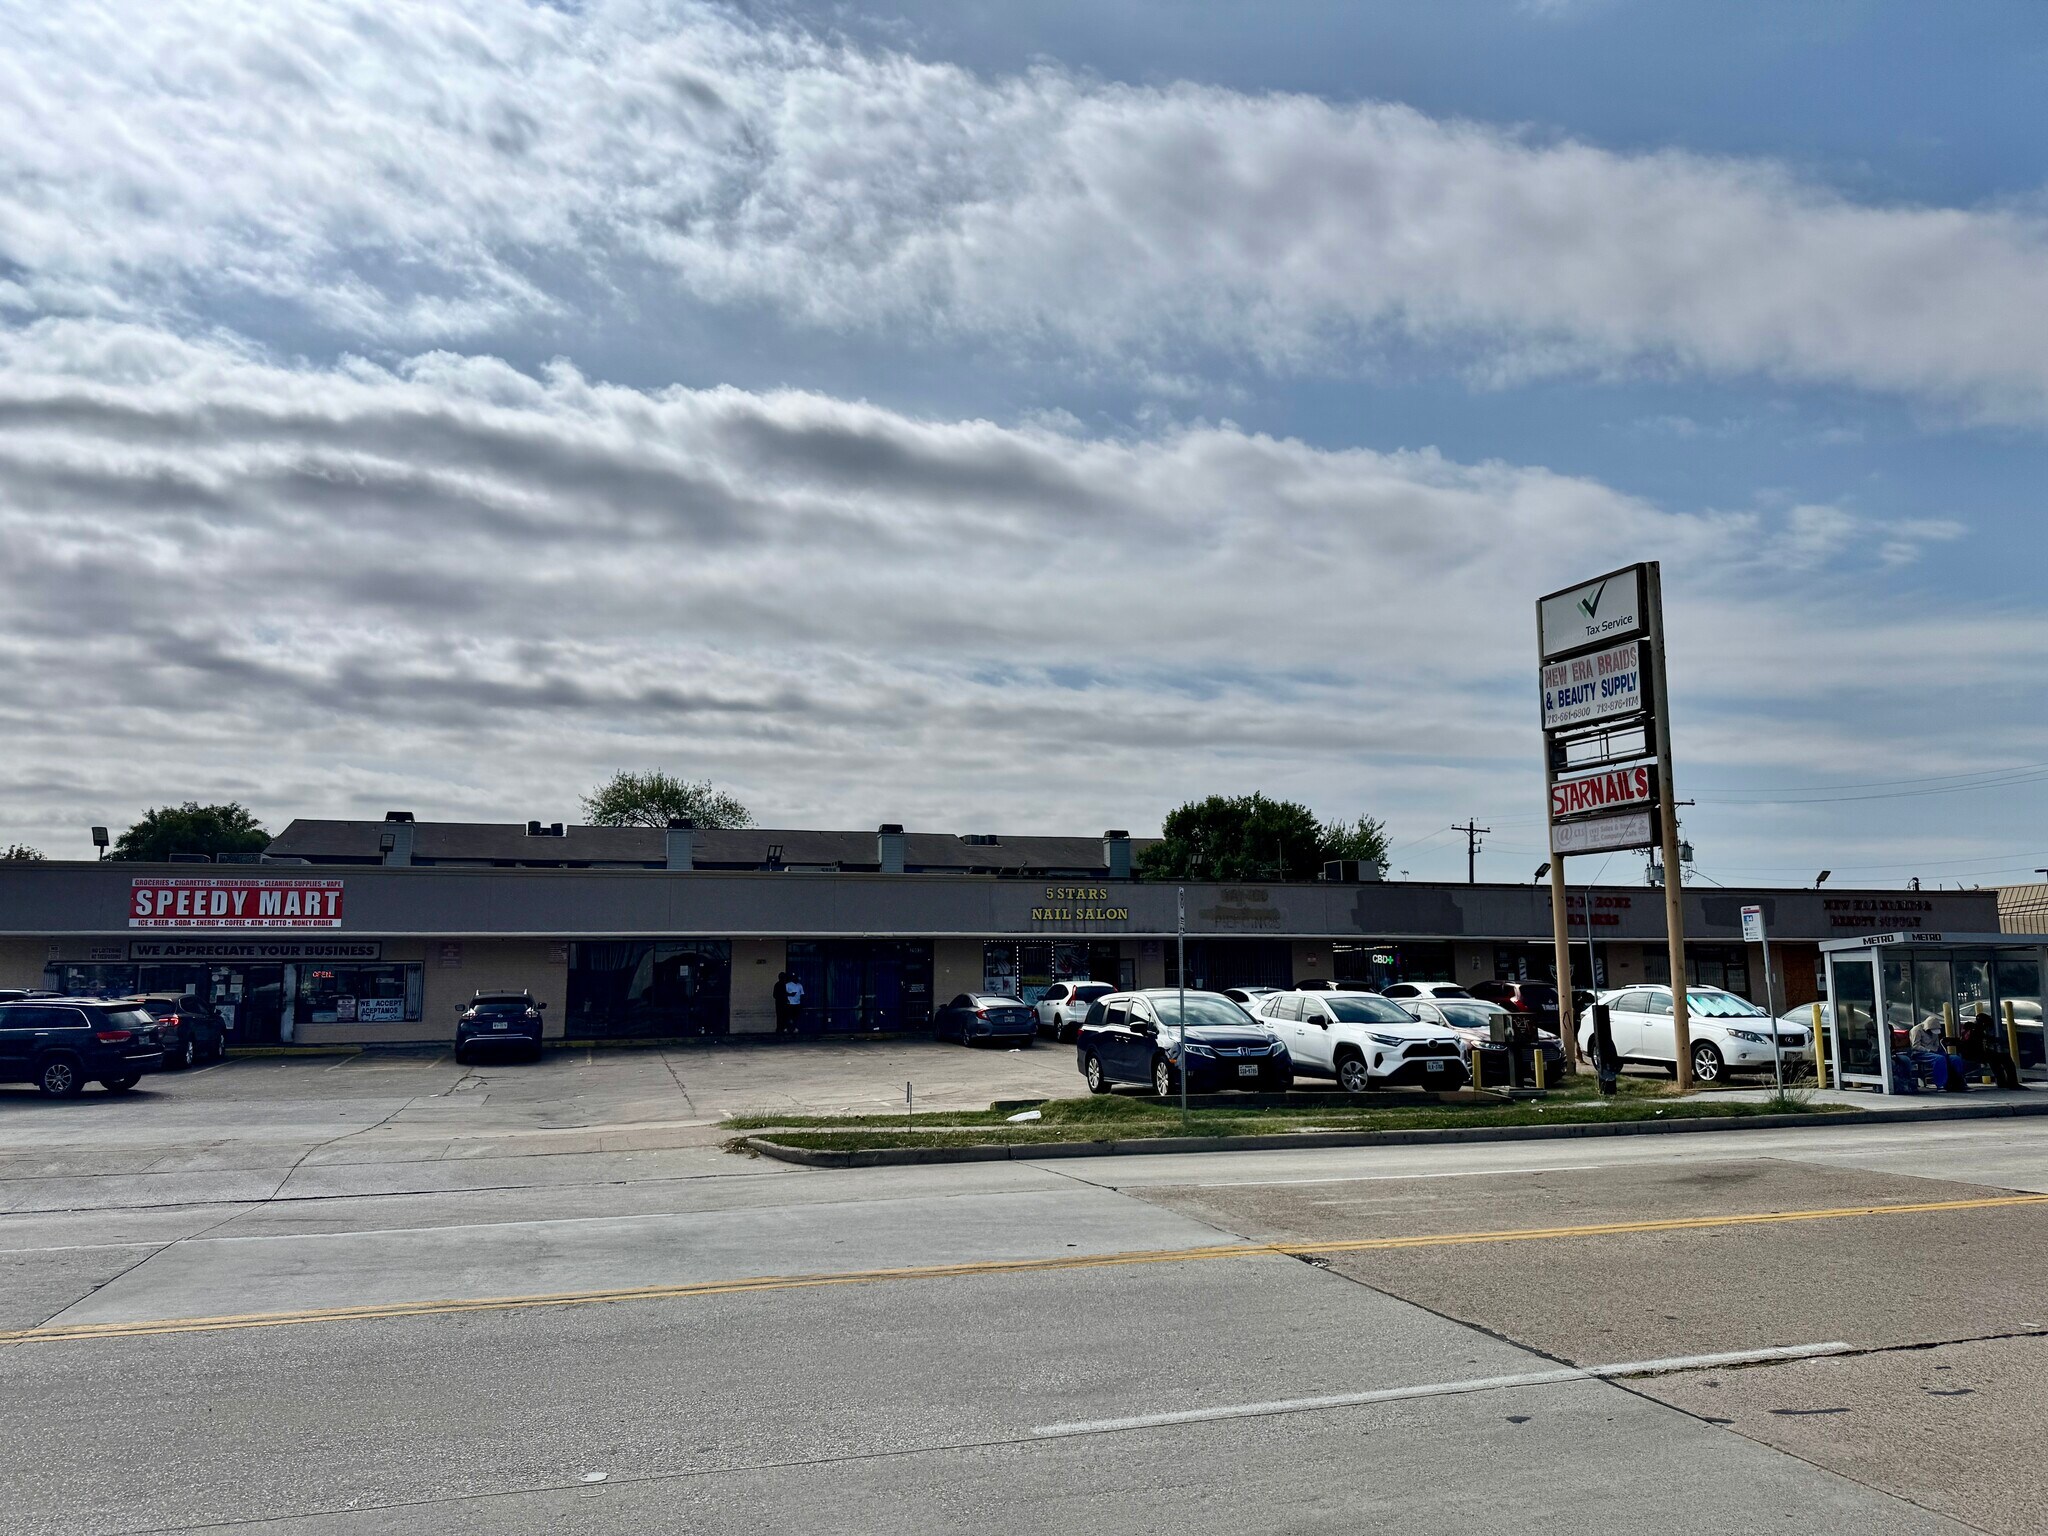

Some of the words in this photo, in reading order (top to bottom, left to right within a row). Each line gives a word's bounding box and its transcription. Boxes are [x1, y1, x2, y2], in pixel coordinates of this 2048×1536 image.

[1586, 626, 1600, 636] Tax
[1602, 615, 1633, 632] Service
[1545, 666, 1567, 688] NEW
[1572, 659, 1593, 682] ERA
[1597, 646, 1637, 676] BRAIDS
[1546, 691, 1553, 711] &
[1558, 681, 1596, 708] BEAUTY
[1601, 671, 1637, 698] SUPPLY
[1046, 887, 1054, 899] 5
[1057, 888, 1107, 900] STARS
[136, 889, 248, 916] SPEEDY
[259, 891, 340, 916] MART
[1031, 908, 1072, 920] NAIL
[1076, 908, 1128, 920] SALON
[1863, 934, 1894, 945] METRO
[1912, 933, 1942, 941] METRO
[137, 945, 161, 956] WE
[164, 945, 254, 956] APPRECIATE
[258, 946, 300, 956] YOUR
[305, 946, 374, 956] BUSINESS
